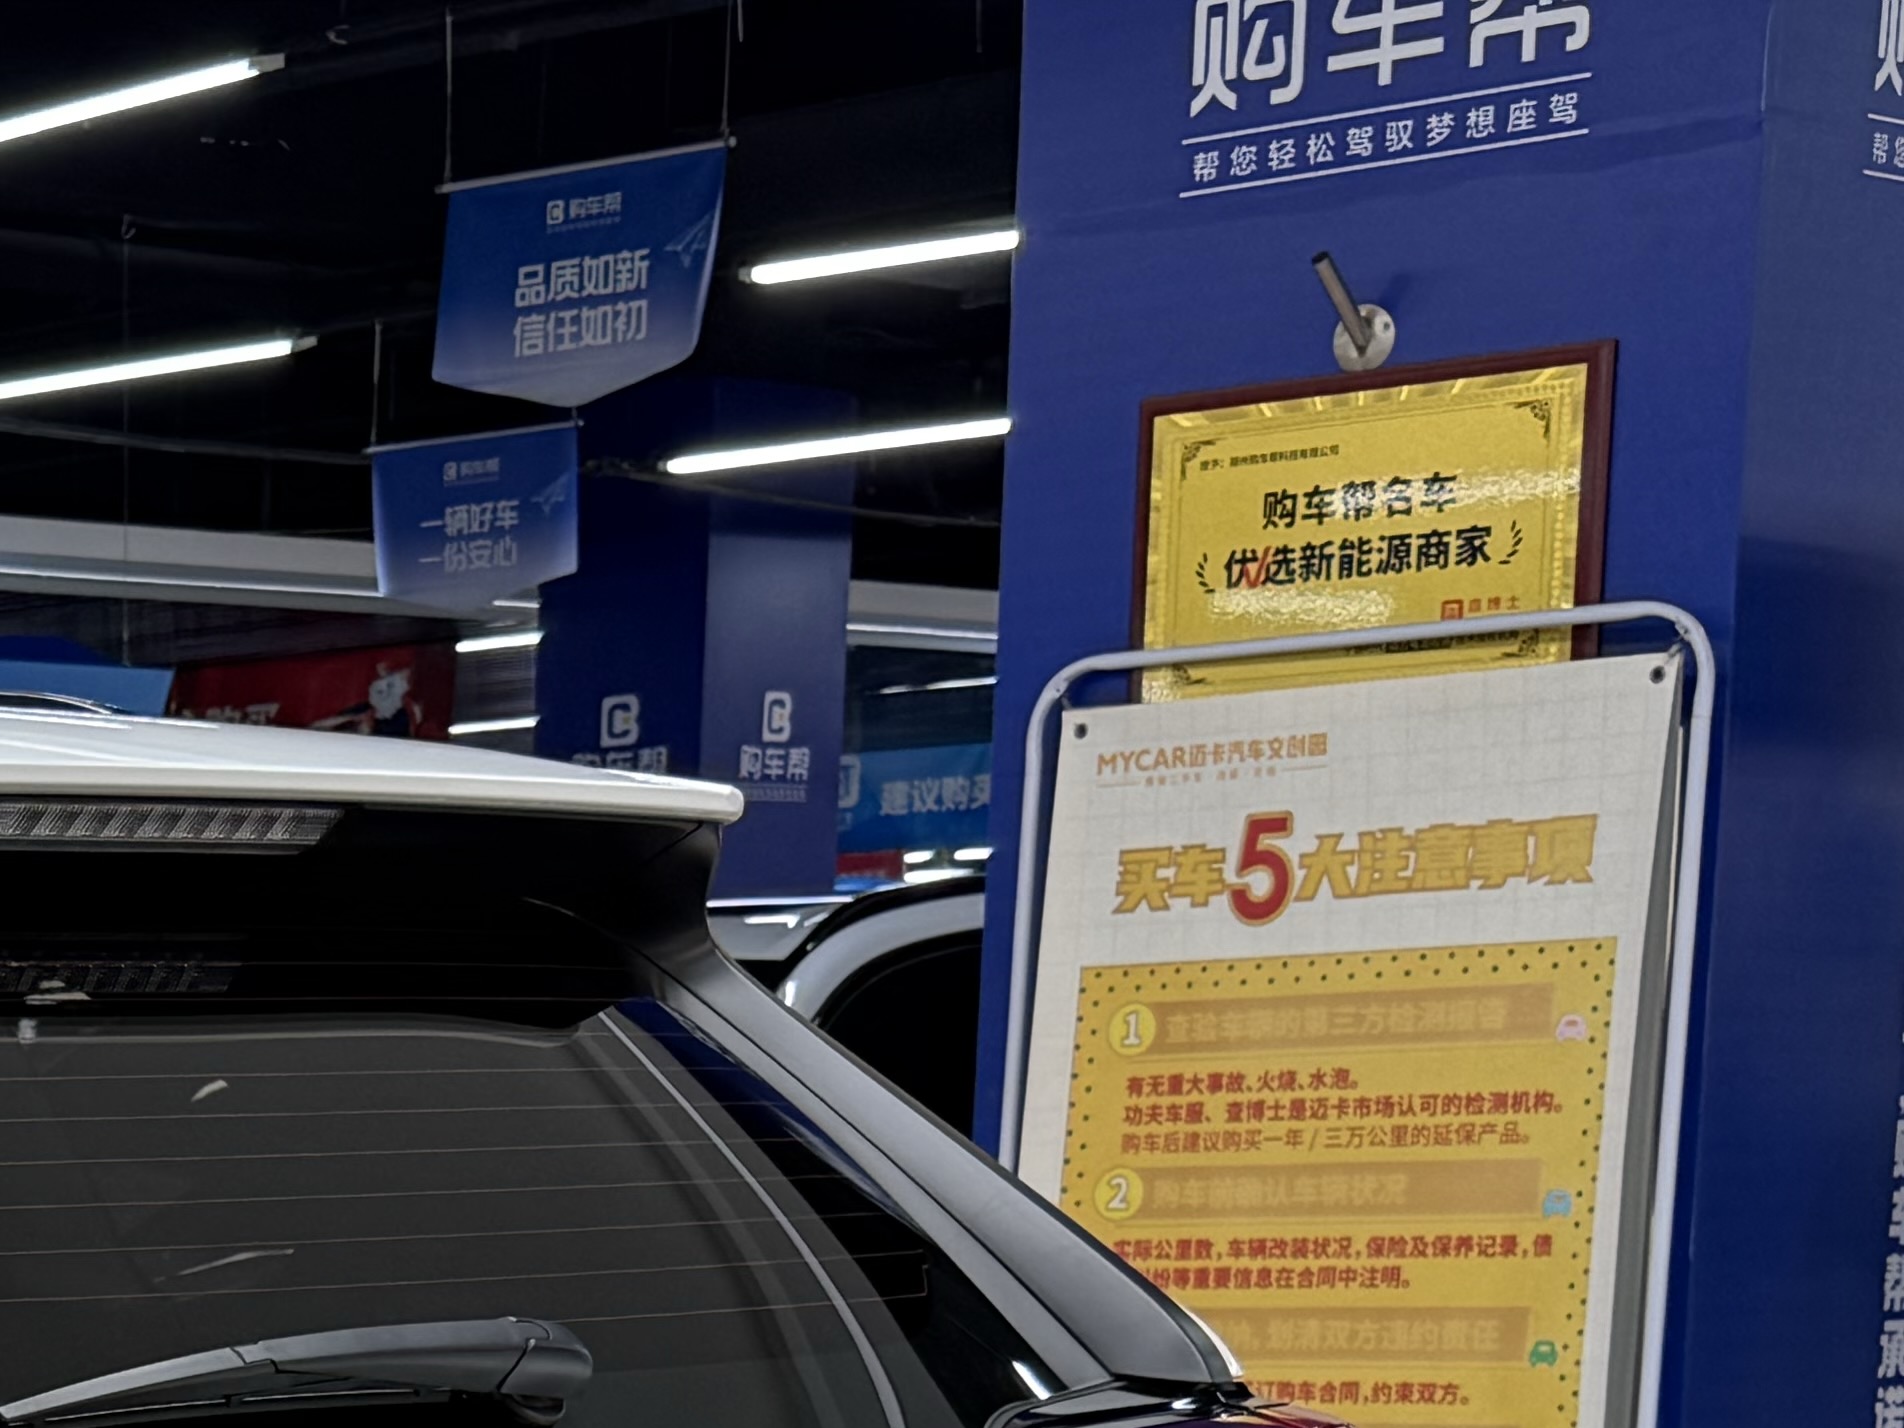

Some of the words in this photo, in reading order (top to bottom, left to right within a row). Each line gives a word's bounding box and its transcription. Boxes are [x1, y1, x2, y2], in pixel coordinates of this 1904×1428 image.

[1192, 92, 1579, 183] 帮您轻松驾驭梦想座驾
[513, 248, 651, 308] 品质如新
[512, 298, 649, 359] 信任如初
[418, 500, 520, 538] 一辆好车
[1261, 471, 1458, 530] 购车帮名车
[417, 535, 518, 574] 一份安心
[1223, 524, 1493, 590] 优选新能源商家
[738, 744, 811, 782] 购车帮
[1112, 810, 1599, 926] 买车5大注意事项
[1123, 1012, 1141, 1046] 1
[1125, 1067, 1360, 1099] 有无重大事故、火烧、水泡。
[1122, 1091, 1564, 1127] 功夫车服、查博士是迈卡市场认可的检测机构。
[1106, 1176, 1129, 1210] 2
